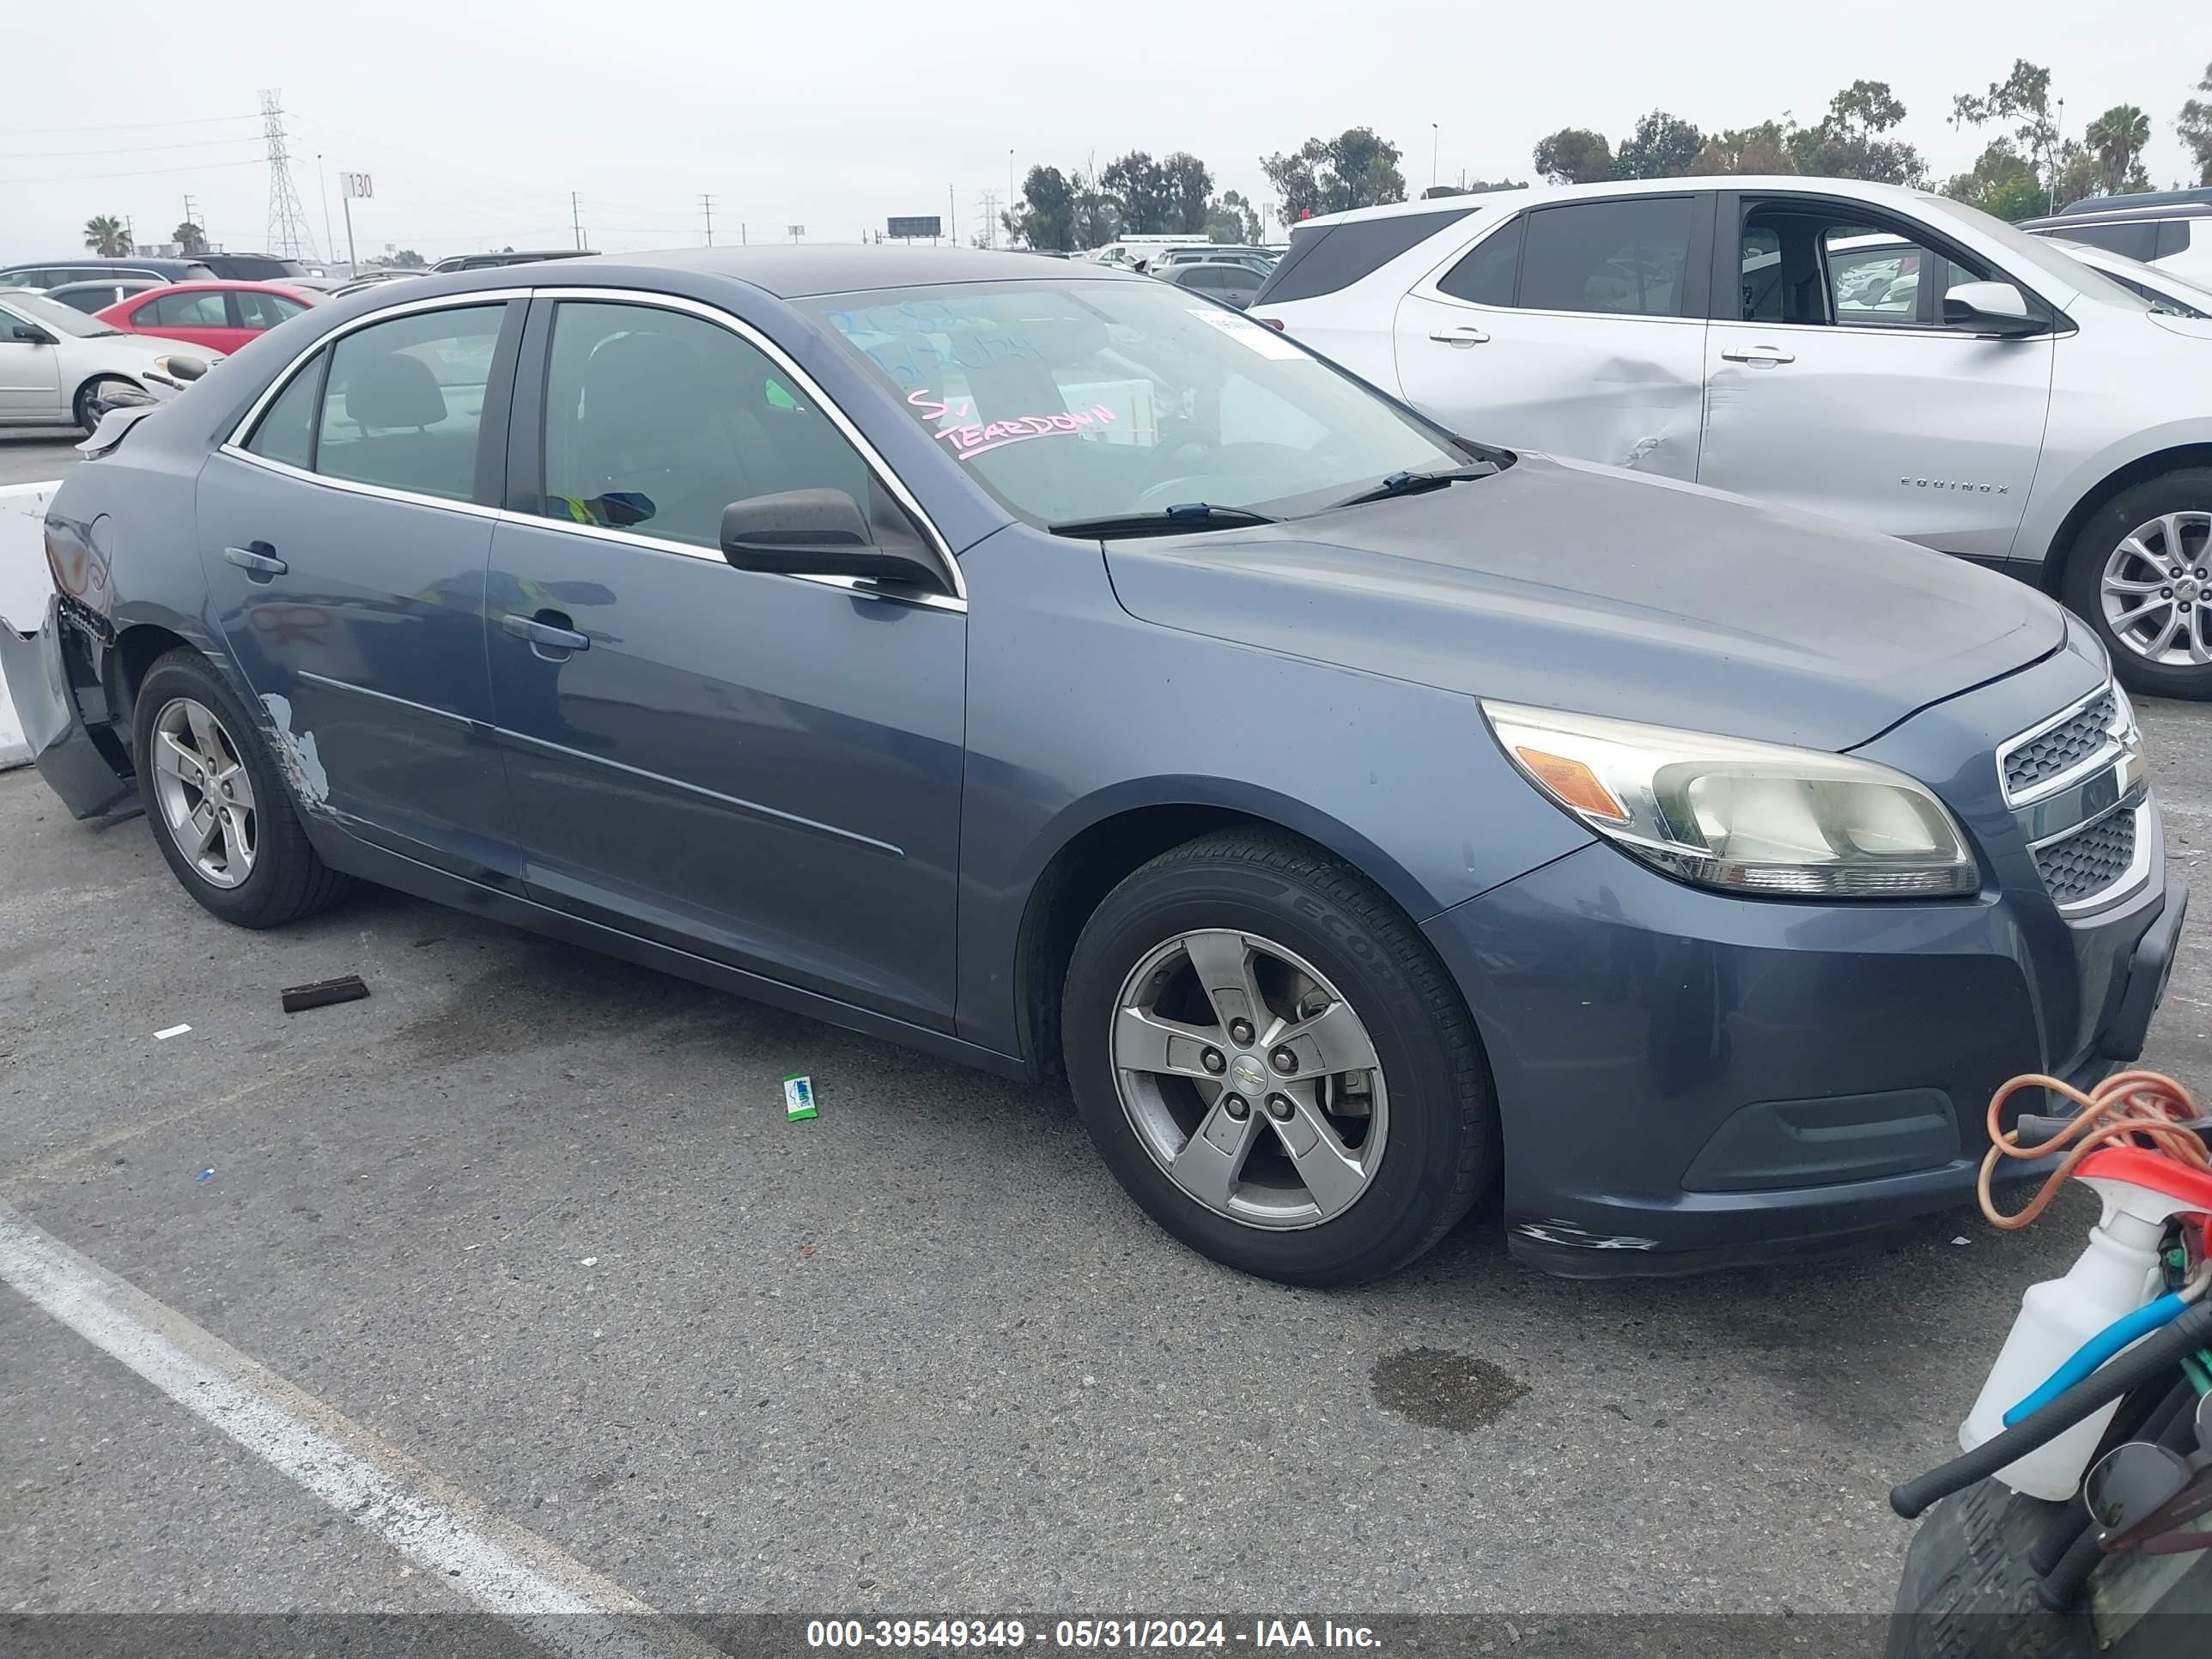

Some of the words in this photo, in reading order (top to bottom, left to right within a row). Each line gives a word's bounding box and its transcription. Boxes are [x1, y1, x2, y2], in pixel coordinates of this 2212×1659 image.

[349, 173, 373, 198] 130
[935, 404, 1116, 450] TEARDOWN
[1900, 476, 2010, 495] EQUINOX
